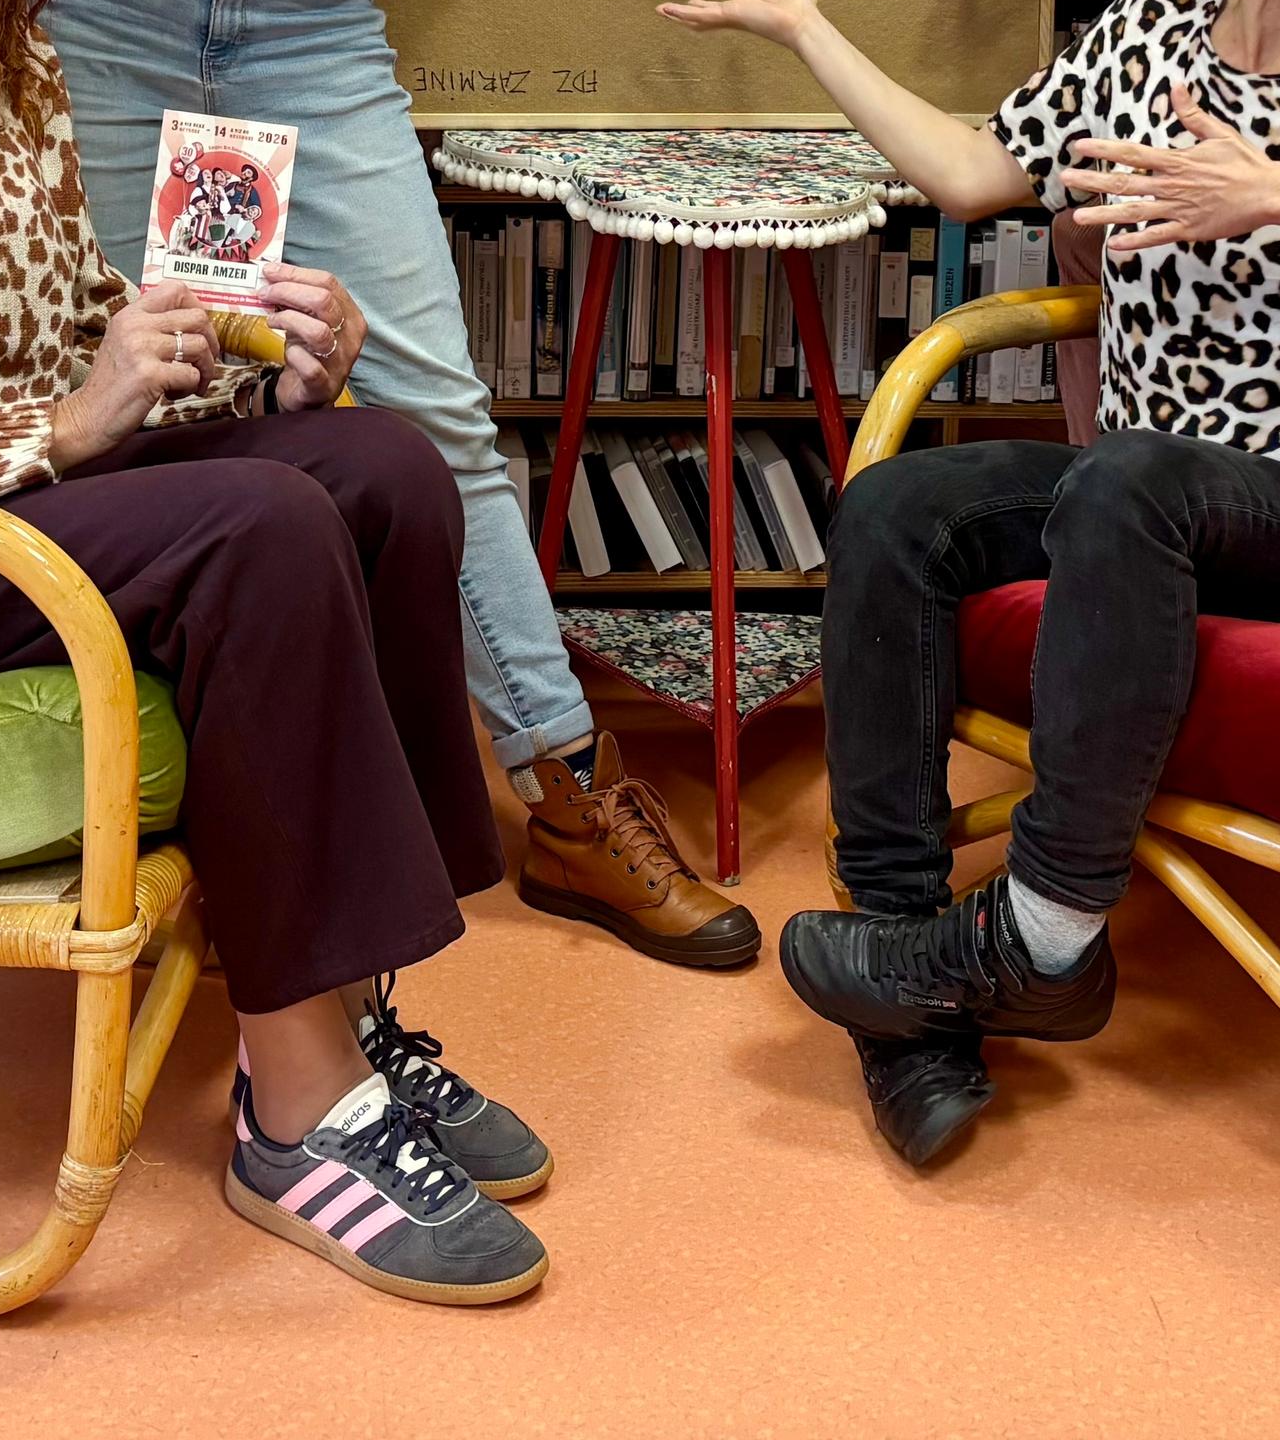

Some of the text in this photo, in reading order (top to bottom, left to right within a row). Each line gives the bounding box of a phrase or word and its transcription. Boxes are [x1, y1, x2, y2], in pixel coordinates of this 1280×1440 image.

[553, 69, 598, 94] FDZ
[257, 131, 289, 146] 2026
[181, 146, 194, 158] 30
[173, 260, 248, 281] DISPAR AMZER
